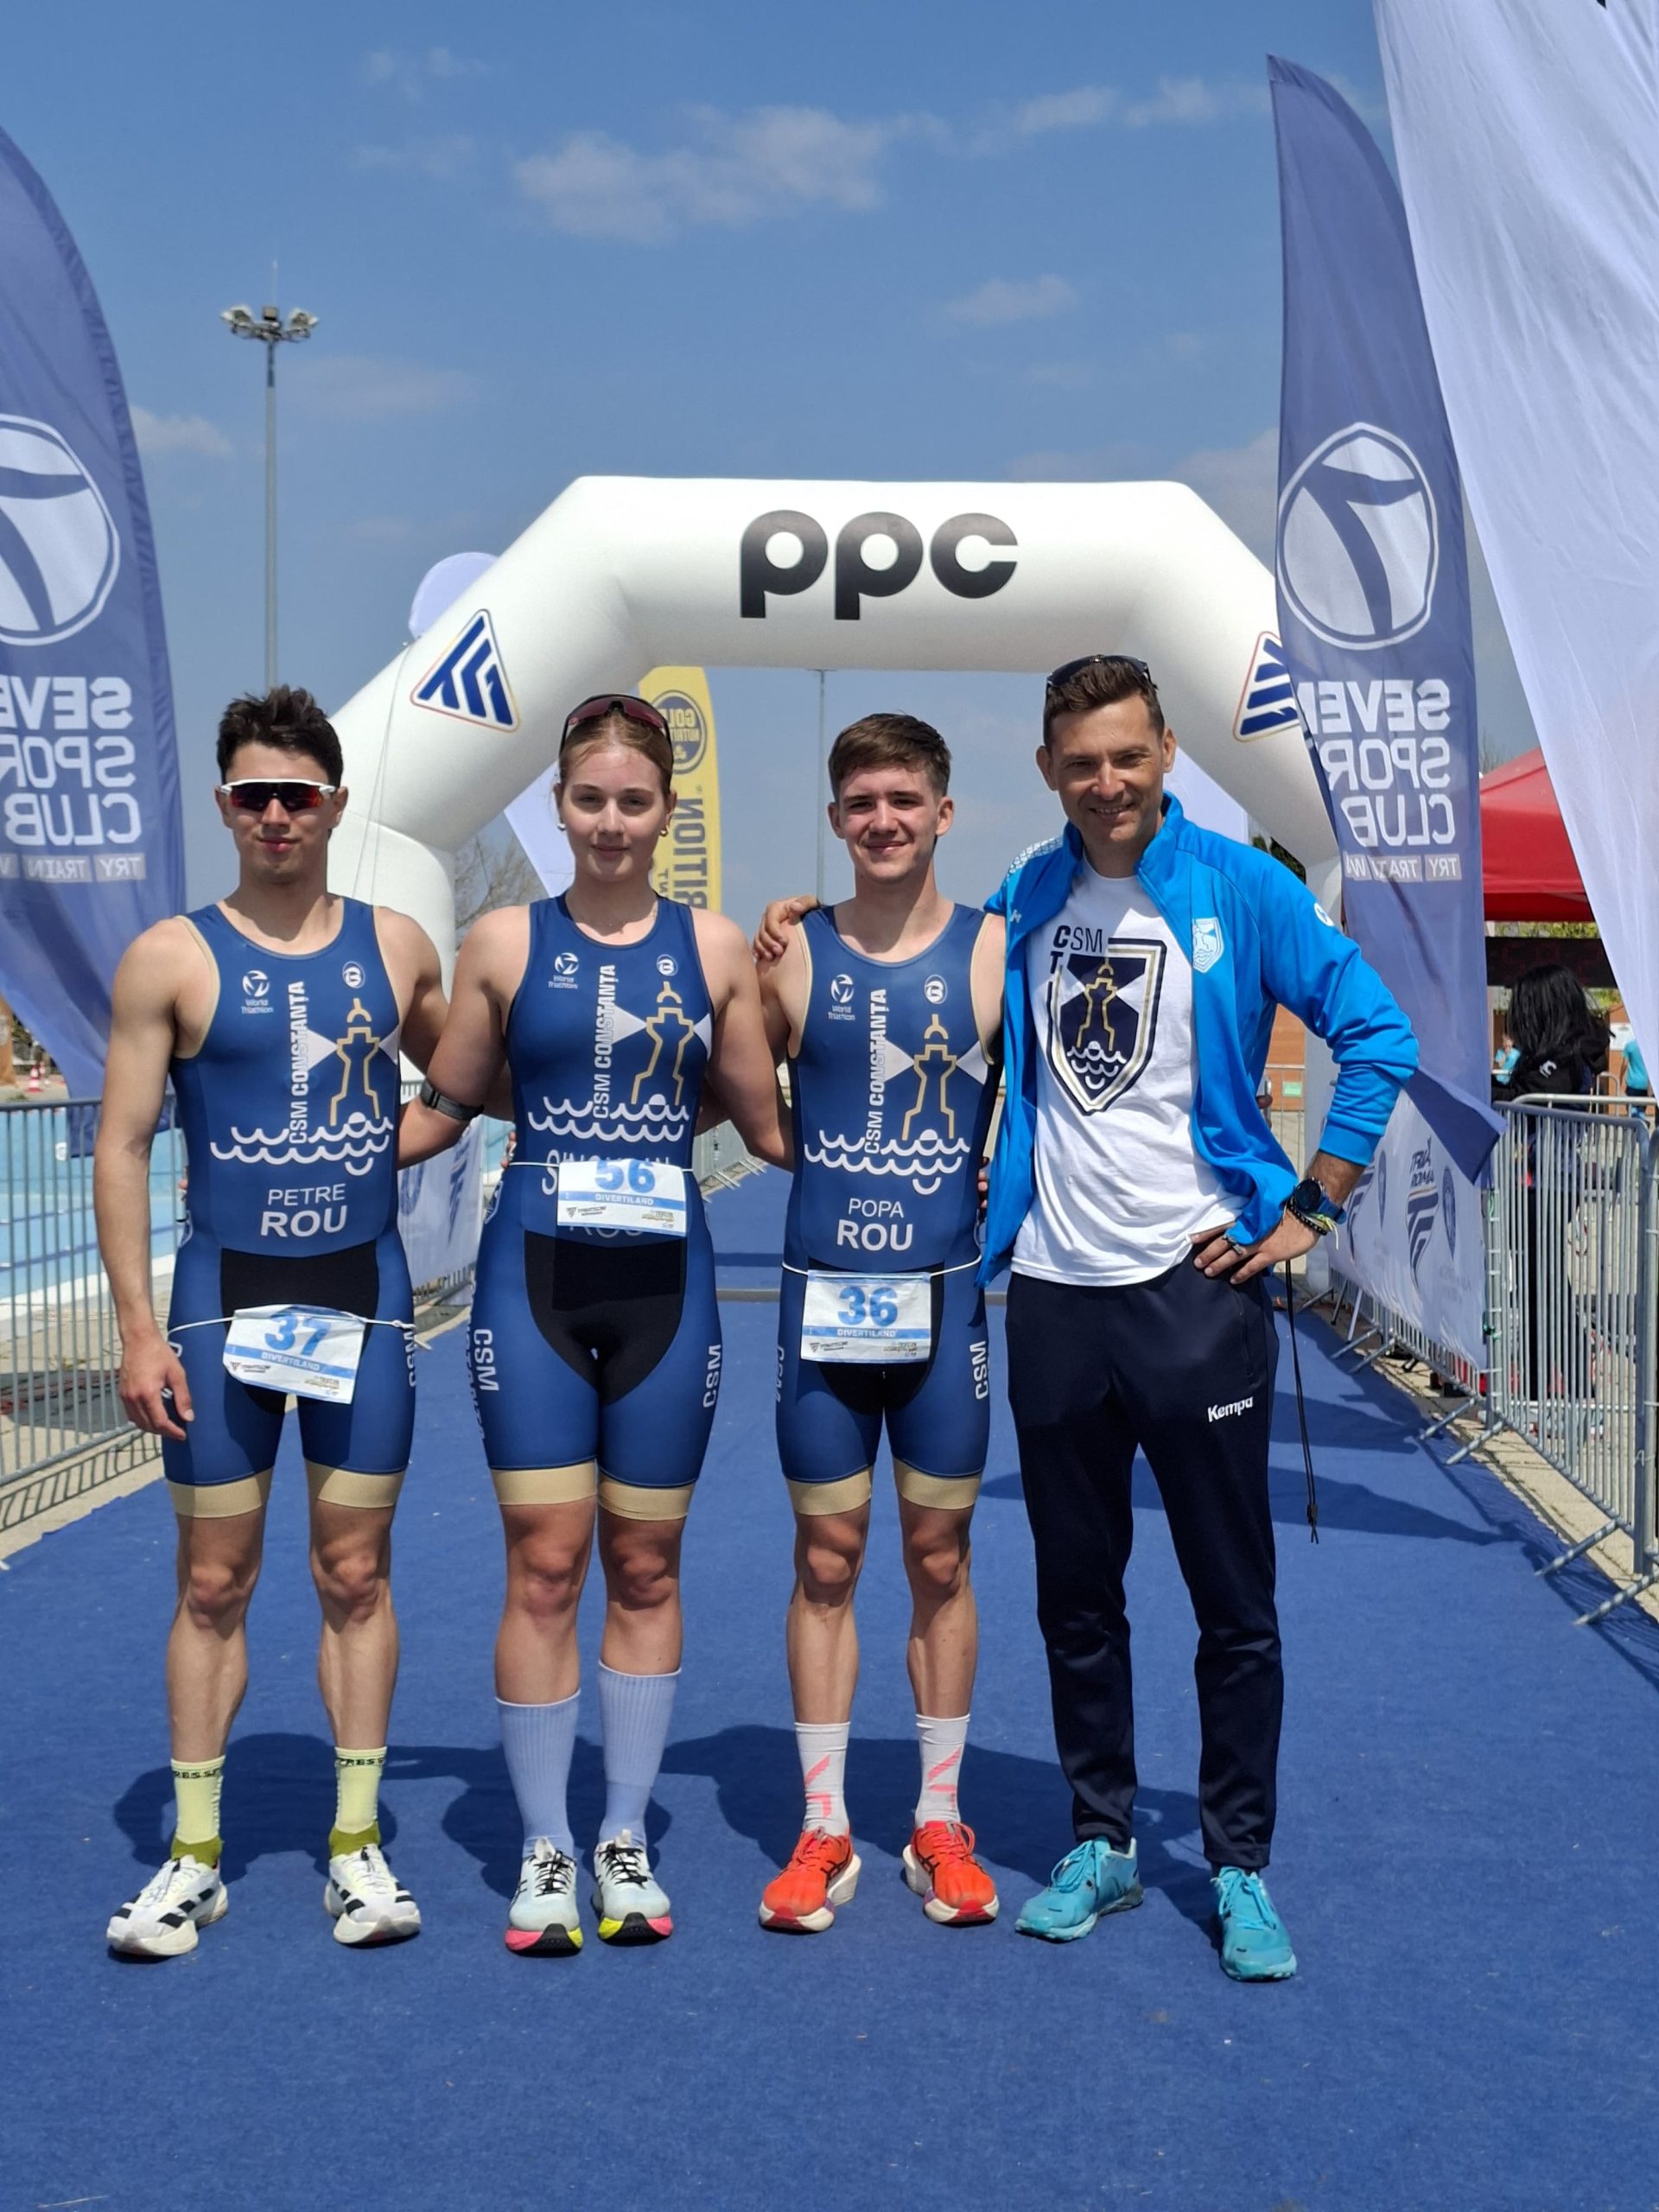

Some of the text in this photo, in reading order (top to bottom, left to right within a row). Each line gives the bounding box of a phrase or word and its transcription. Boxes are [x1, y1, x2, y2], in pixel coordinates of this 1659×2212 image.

[740, 509, 1018, 620] ppc
[1053, 925, 1103, 953] CSM
[593, 1074, 611, 1118] CSM
[289, 1101, 308, 1145] CSM
[864, 1111, 882, 1154] CSM
[267, 1183, 346, 1205] PETRE
[594, 1158, 655, 1193] 56
[594, 1193, 654, 1205] DIVERTILAND
[848, 1198, 904, 1218] POPA
[260, 1205, 347, 1237] ROU
[836, 1219, 913, 1251] ROU
[837, 1286, 899, 1327] 36
[264, 1313, 332, 1357] 37
[474, 1329, 499, 1391] CSM
[702, 1344, 721, 1408] CSM
[969, 1340, 988, 1400] CSM
[1207, 1396, 1254, 1422] Kempa
